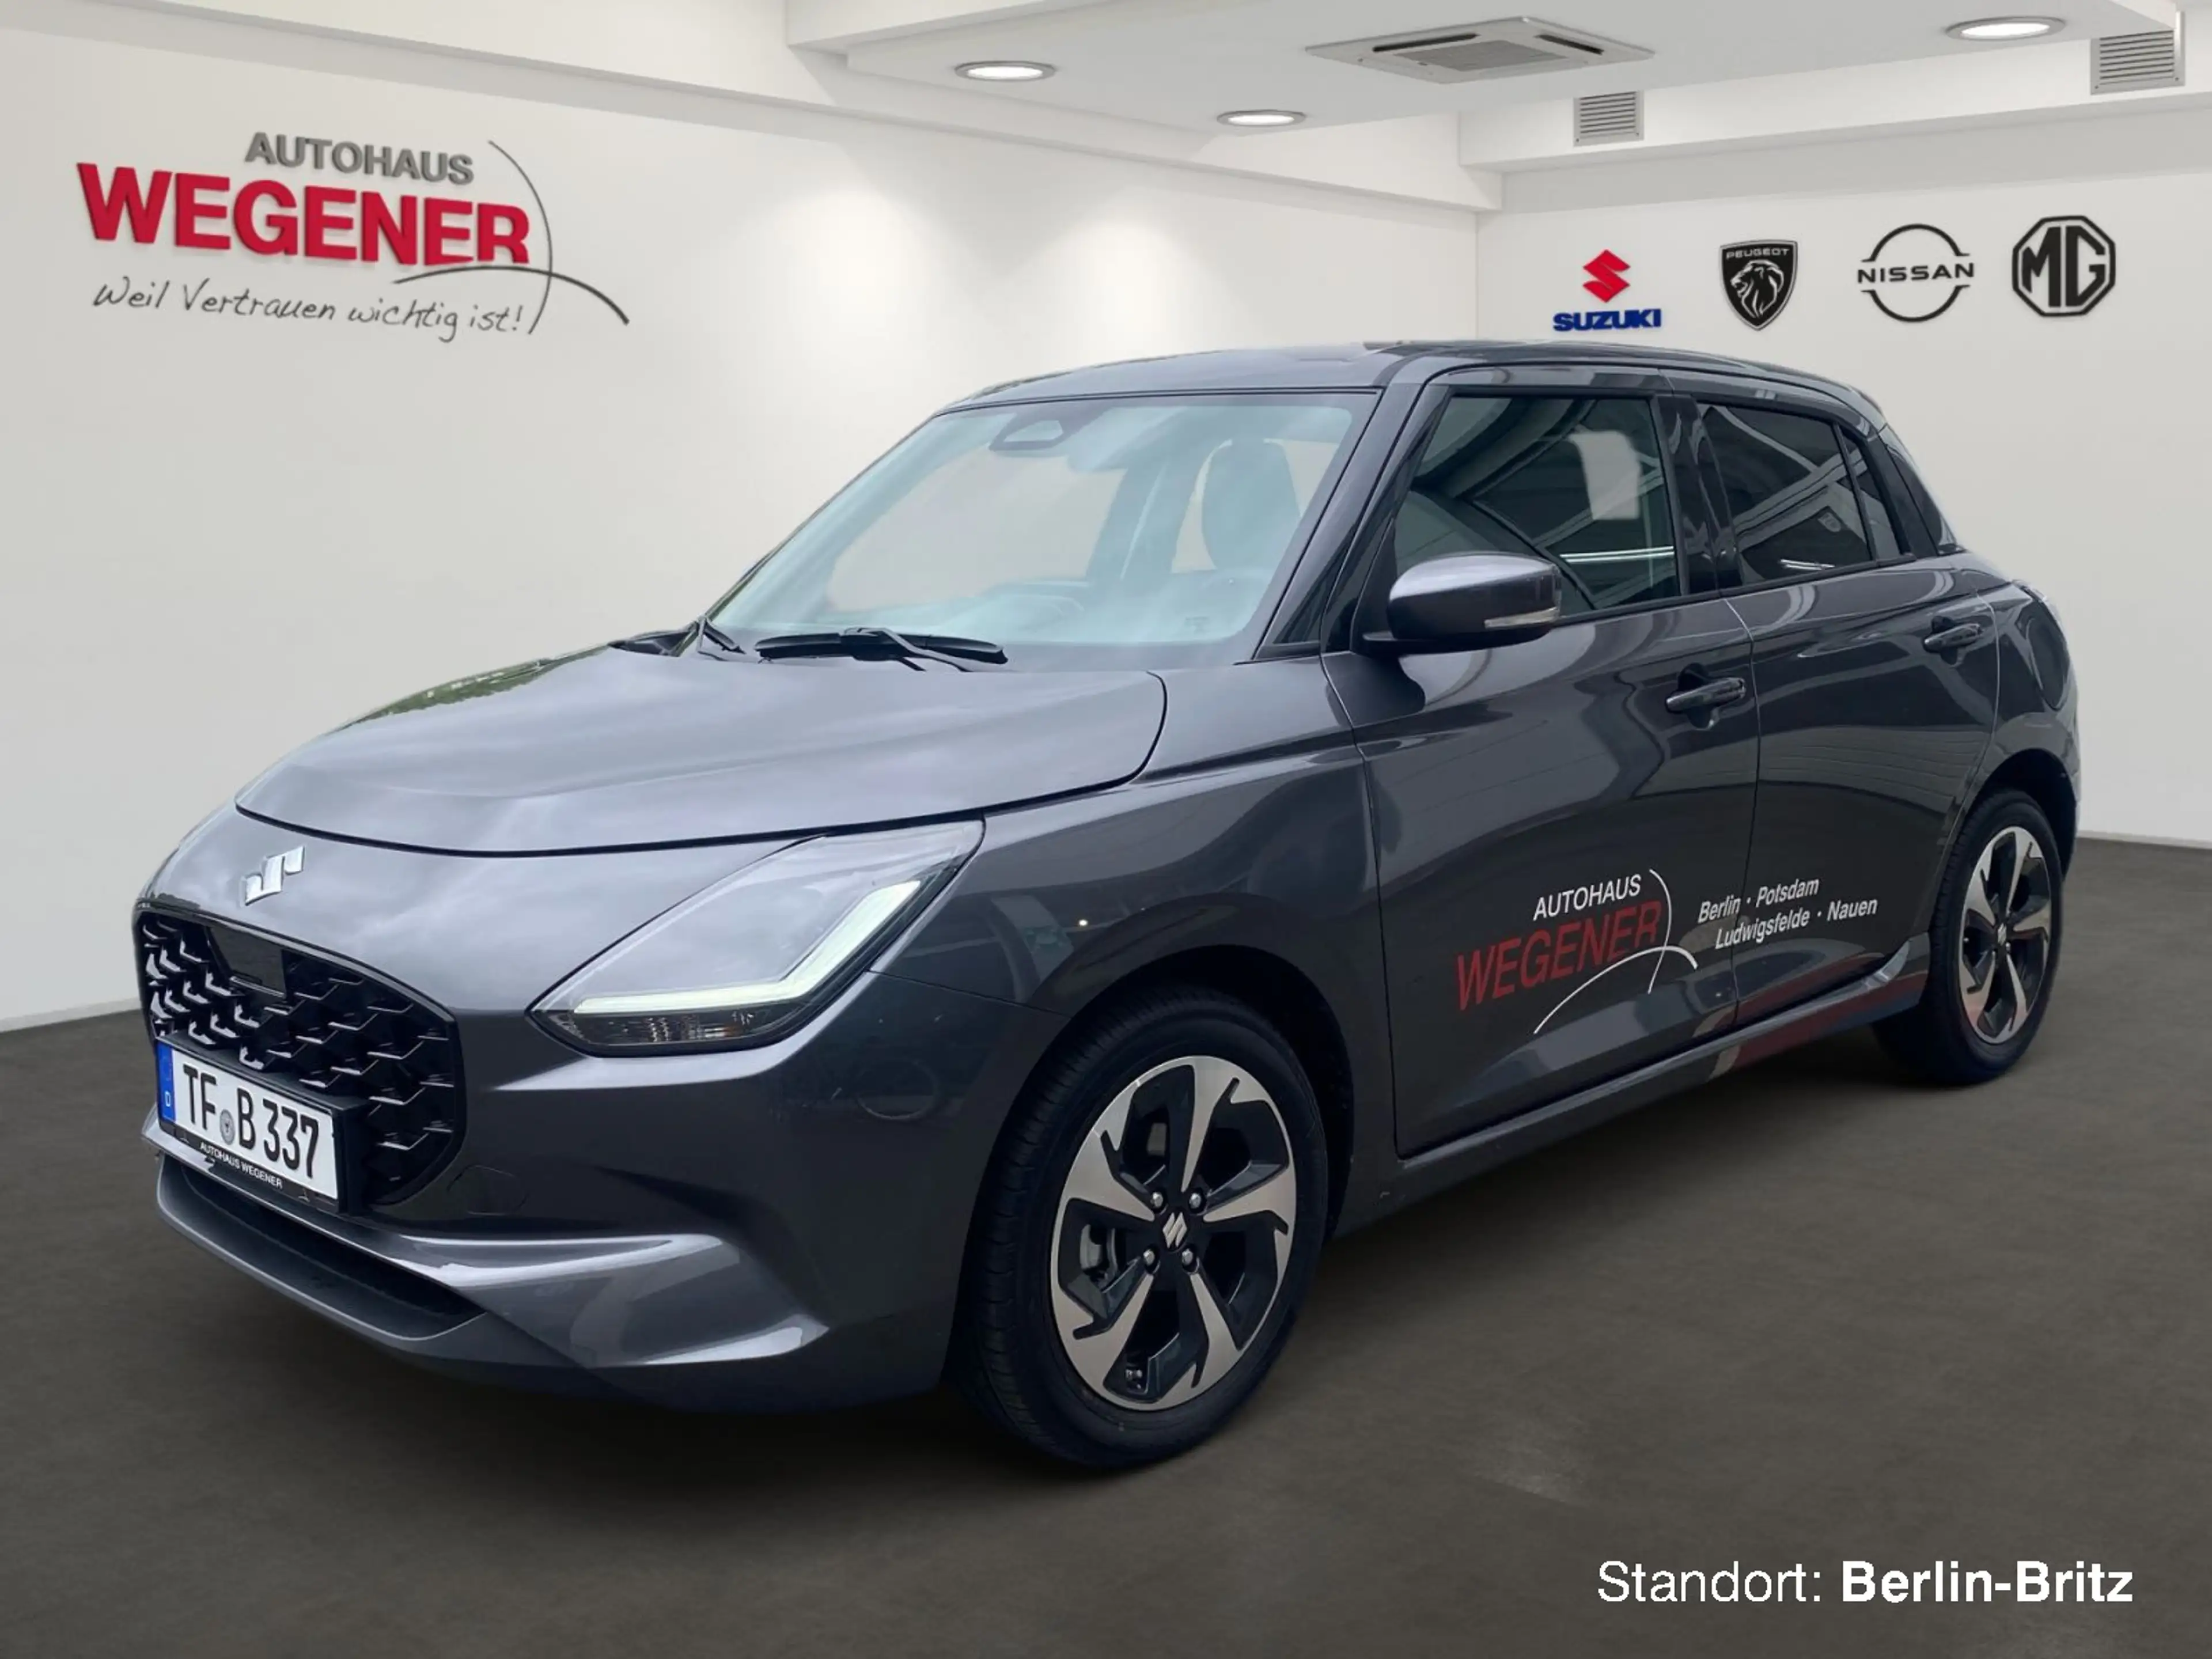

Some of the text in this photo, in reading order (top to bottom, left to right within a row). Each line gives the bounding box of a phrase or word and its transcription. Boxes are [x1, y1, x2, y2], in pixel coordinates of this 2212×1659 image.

[245, 132, 474, 185] AUTOHAUS
[77, 162, 530, 266] WEGENER
[1726, 248, 1789, 259] PEUGEOT
[1858, 263, 1974, 283] NISSAN
[2021, 225, 2107, 308] MG
[93, 276, 523, 343] Weil Vertrauen wichtig ist!
[1553, 309, 1662, 331] SUZUKI
[1533, 873, 1642, 921] AUTOHAUS
[1698, 878, 1819, 923] Berlin Potsdam
[1715, 899, 1878, 950] Ludwigsfelde Nauen
[1456, 900, 1662, 1011] WEGENER
[183, 1063, 320, 1179] TF B 337
[200, 1142, 283, 1189] AUTOHAUS WEGENER
